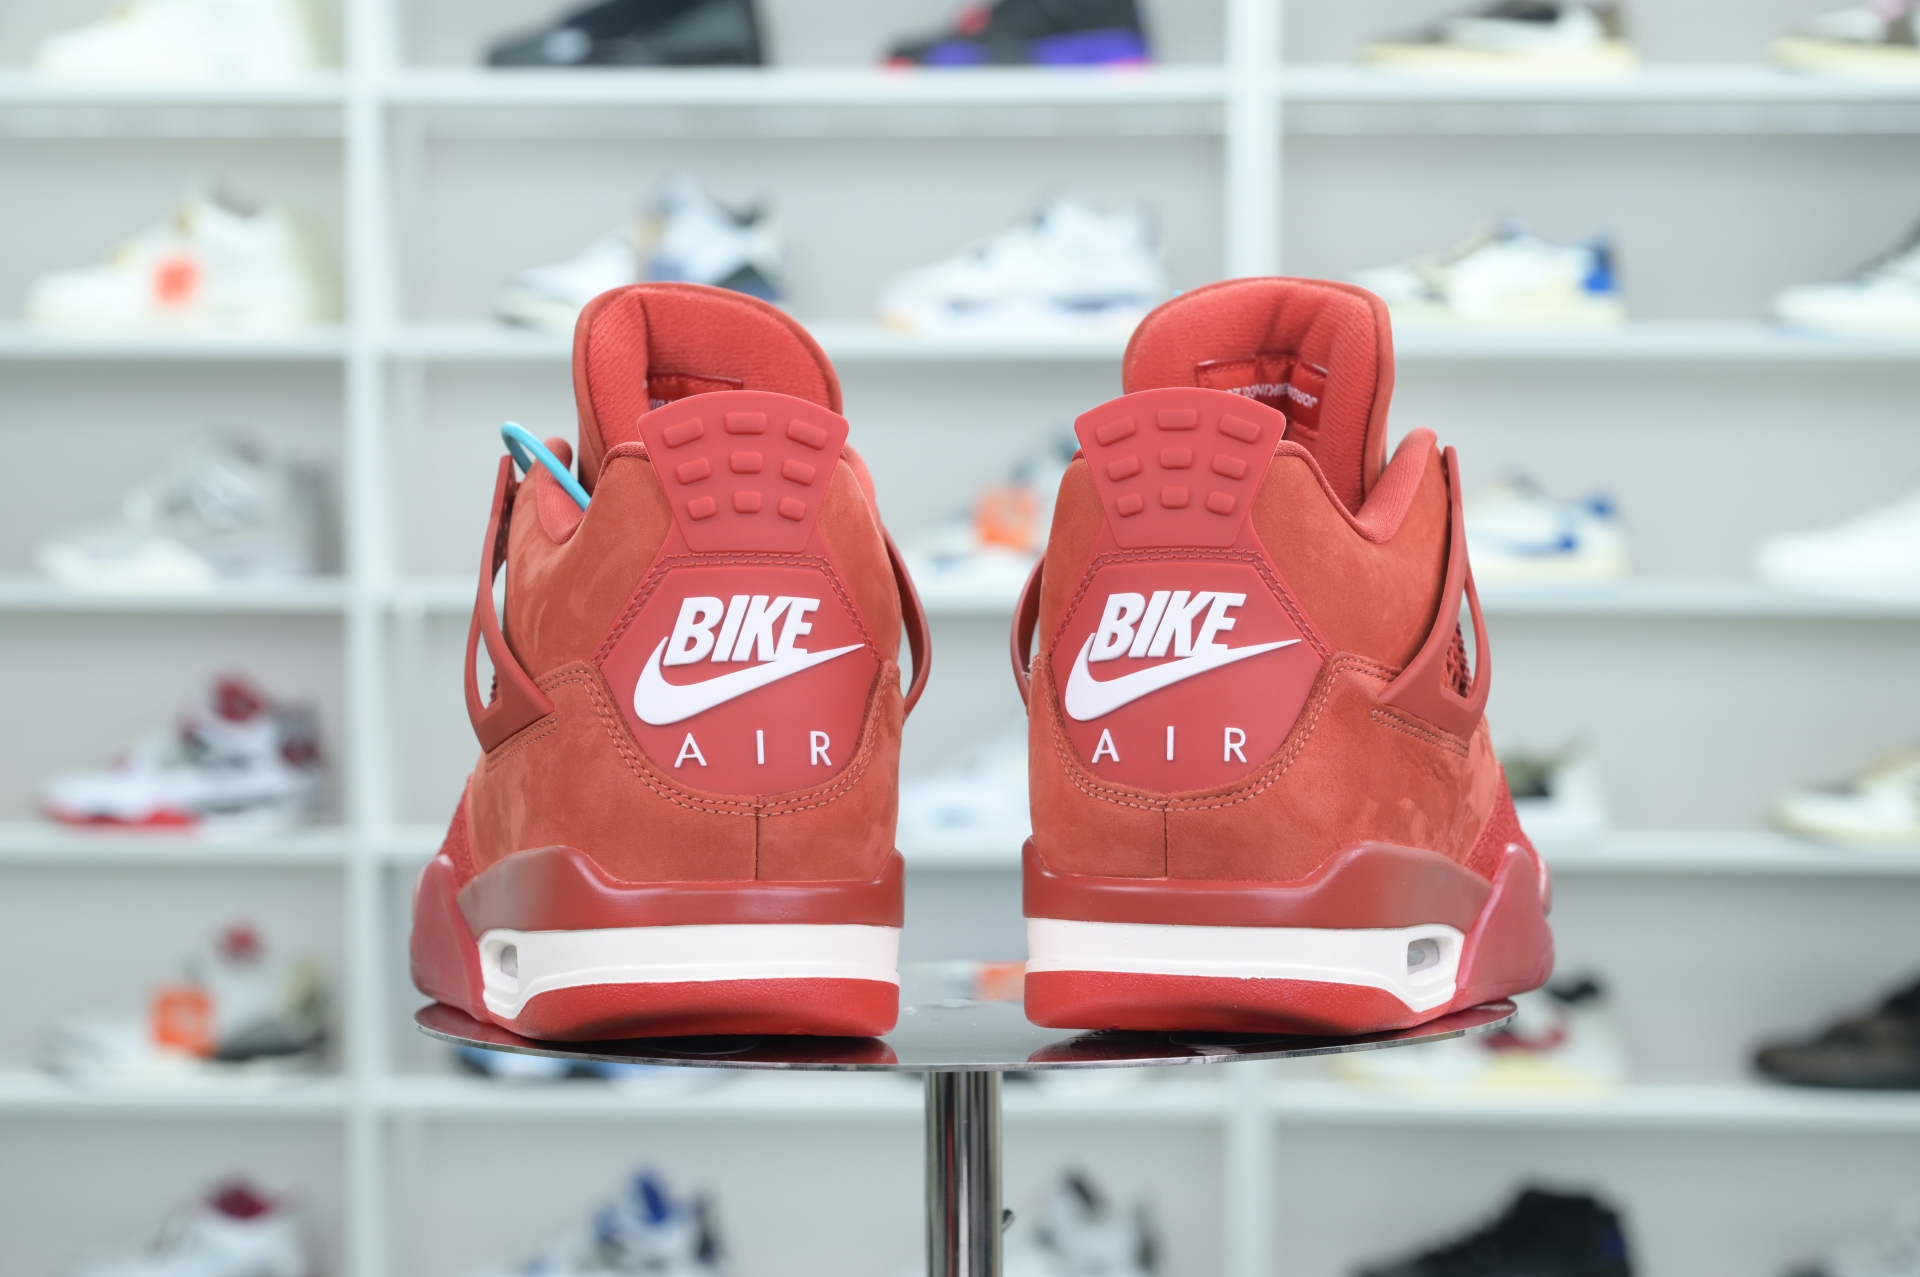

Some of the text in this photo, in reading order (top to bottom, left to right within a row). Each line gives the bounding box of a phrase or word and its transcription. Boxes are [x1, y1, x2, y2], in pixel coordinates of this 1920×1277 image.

[663, 595, 820, 666] BIKE
[1088, 590, 1247, 662] BIKE
[674, 729, 832, 768] AIR
[1091, 725, 1247, 763] AIR
